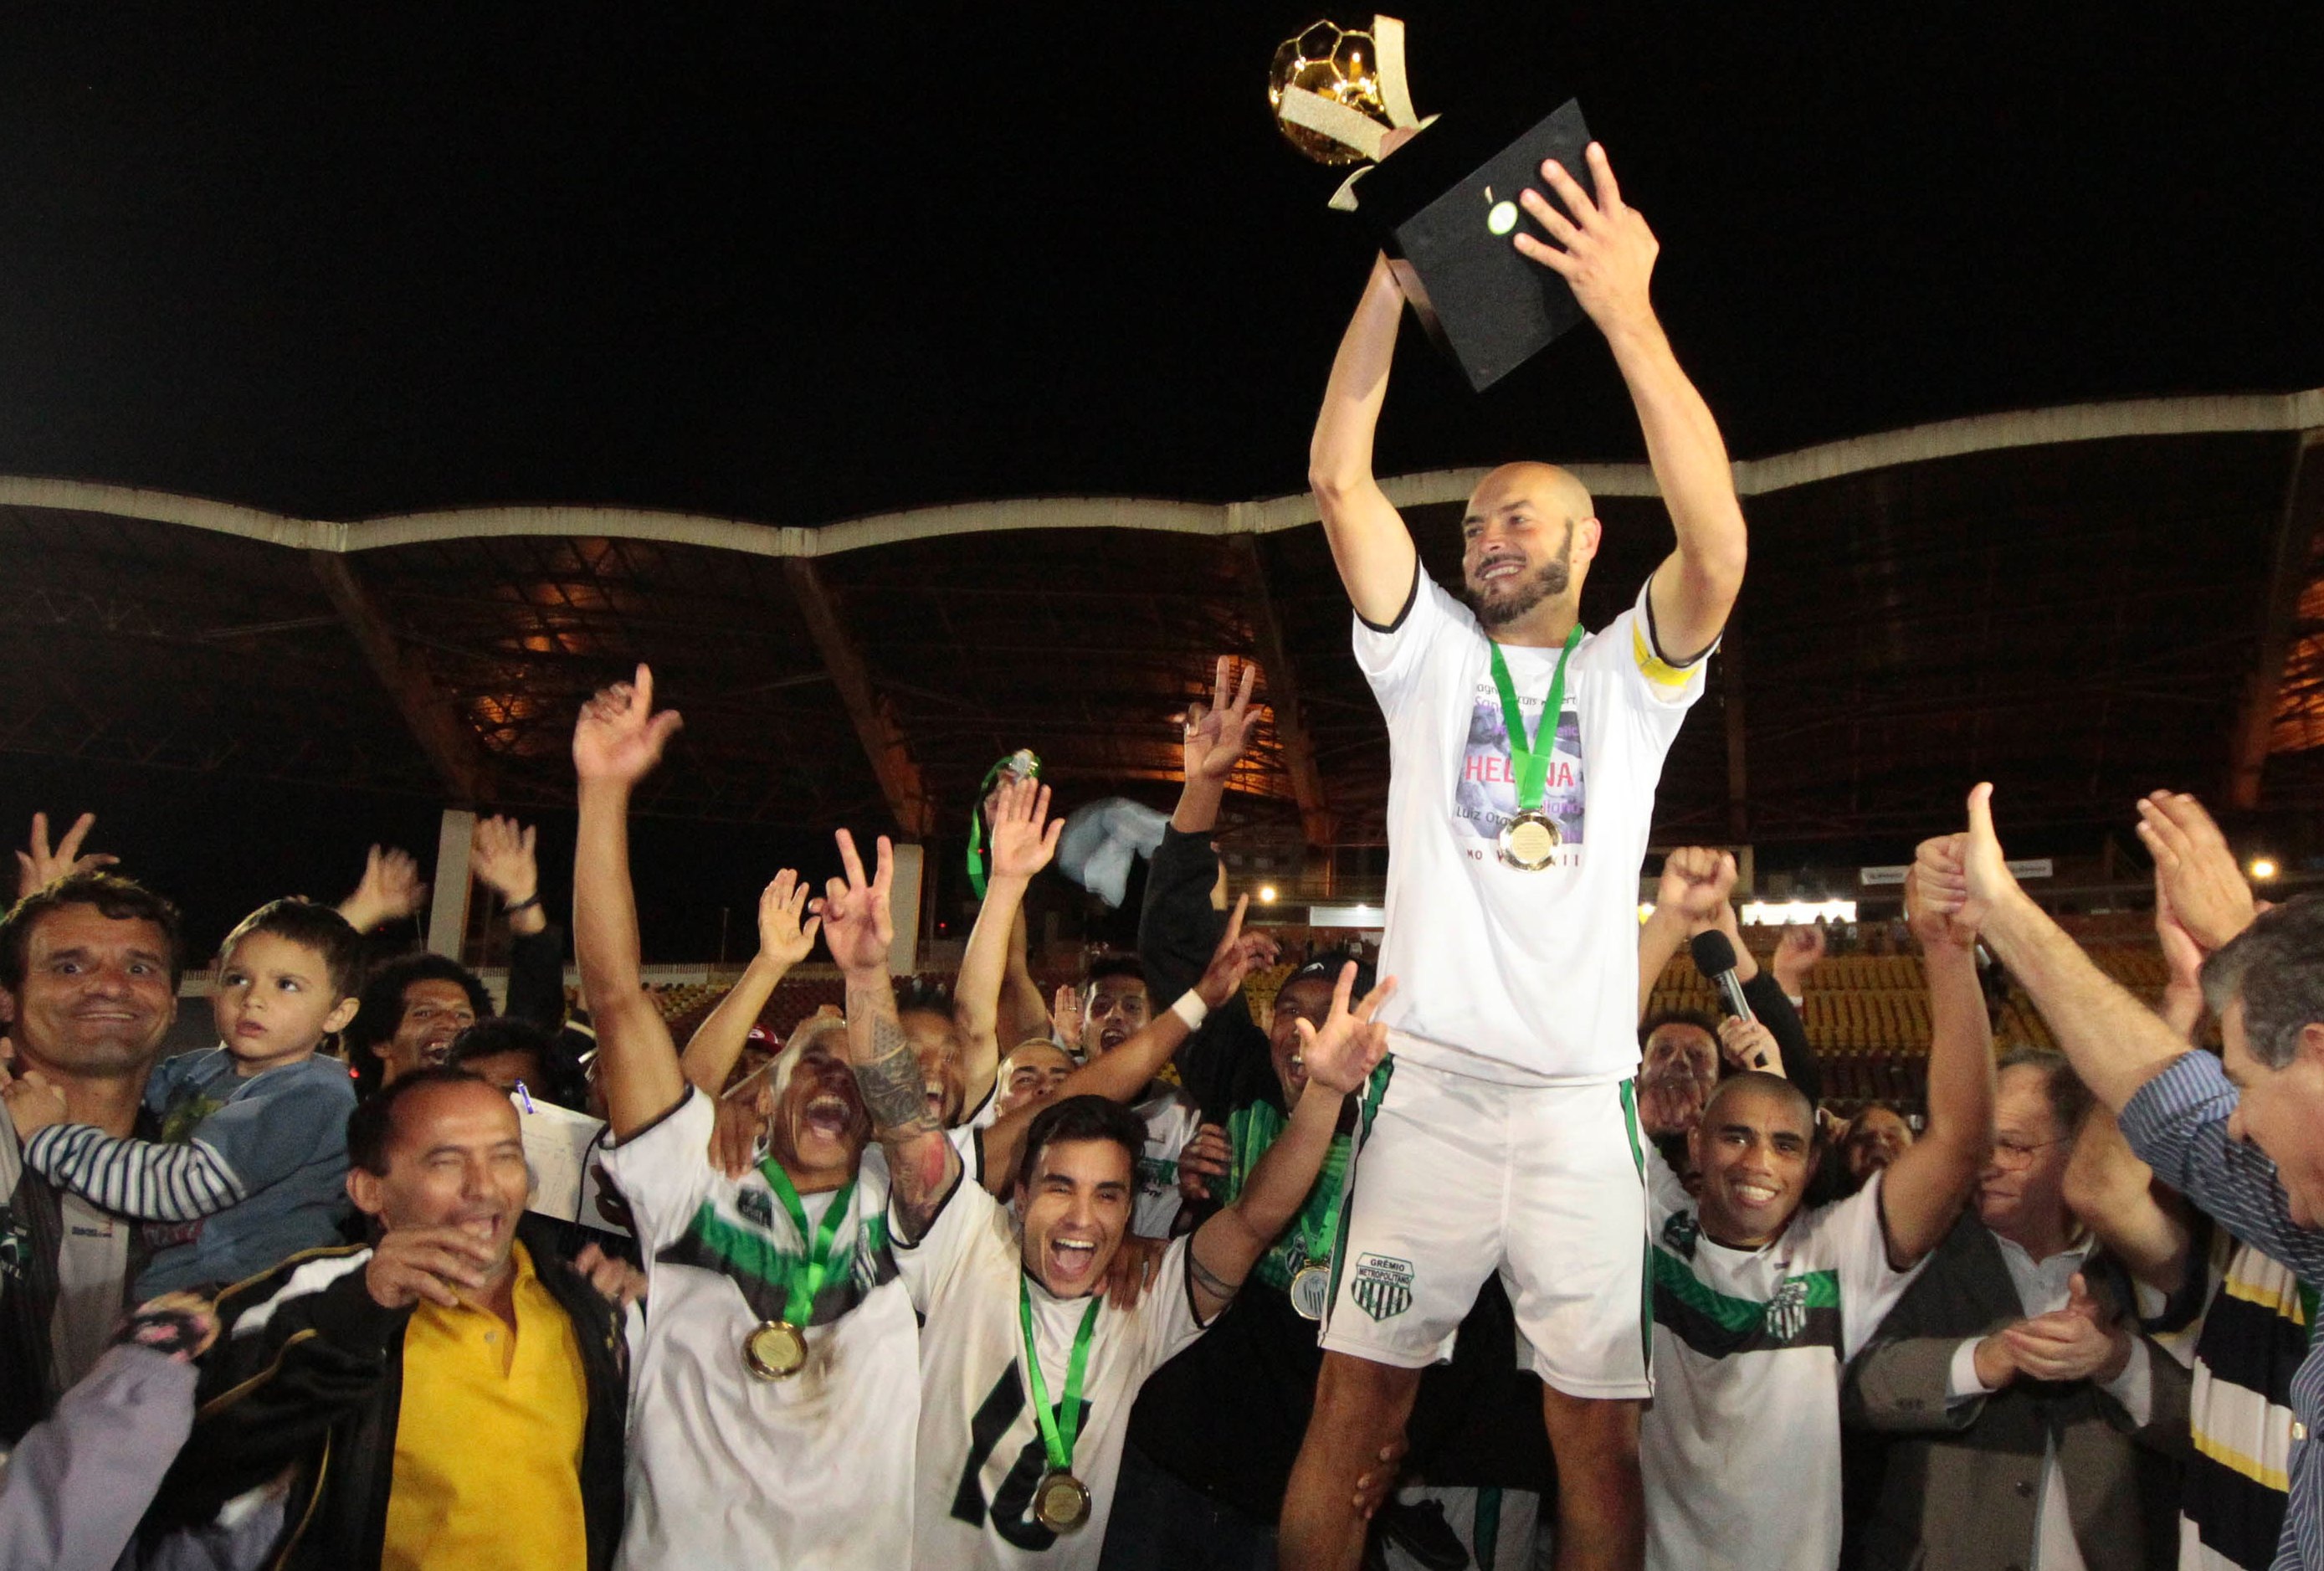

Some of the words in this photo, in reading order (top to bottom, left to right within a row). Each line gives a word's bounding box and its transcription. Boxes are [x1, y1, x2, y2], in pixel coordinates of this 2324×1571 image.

[1465, 755, 1575, 788] HELNA
[1456, 805, 1481, 821] Luiz
[1358, 1266, 1410, 1285] METROPOLITANO
